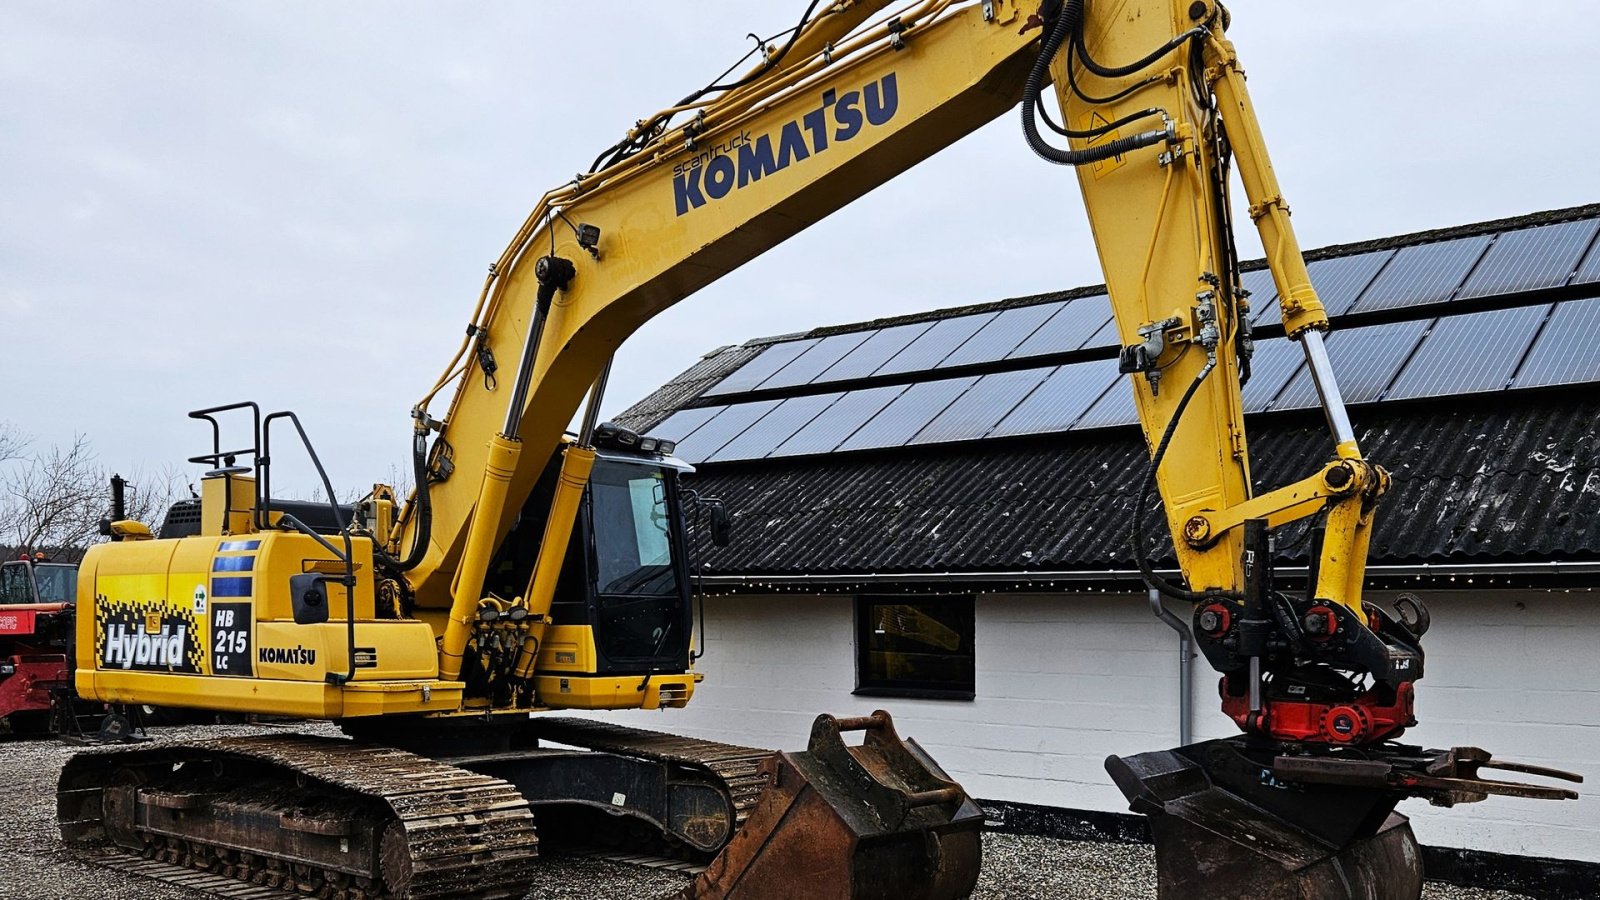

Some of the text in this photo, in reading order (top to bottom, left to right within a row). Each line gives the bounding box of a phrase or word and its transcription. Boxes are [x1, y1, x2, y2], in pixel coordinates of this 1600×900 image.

[672, 71, 899, 217] KOMATSU
[673, 130, 752, 177] scantruck
[215, 610, 234, 627] HB
[105, 624, 186, 669] Hybrid
[215, 630, 247, 653] 215
[216, 656, 229, 669] LC
[259, 645, 316, 665] KOMATSU
